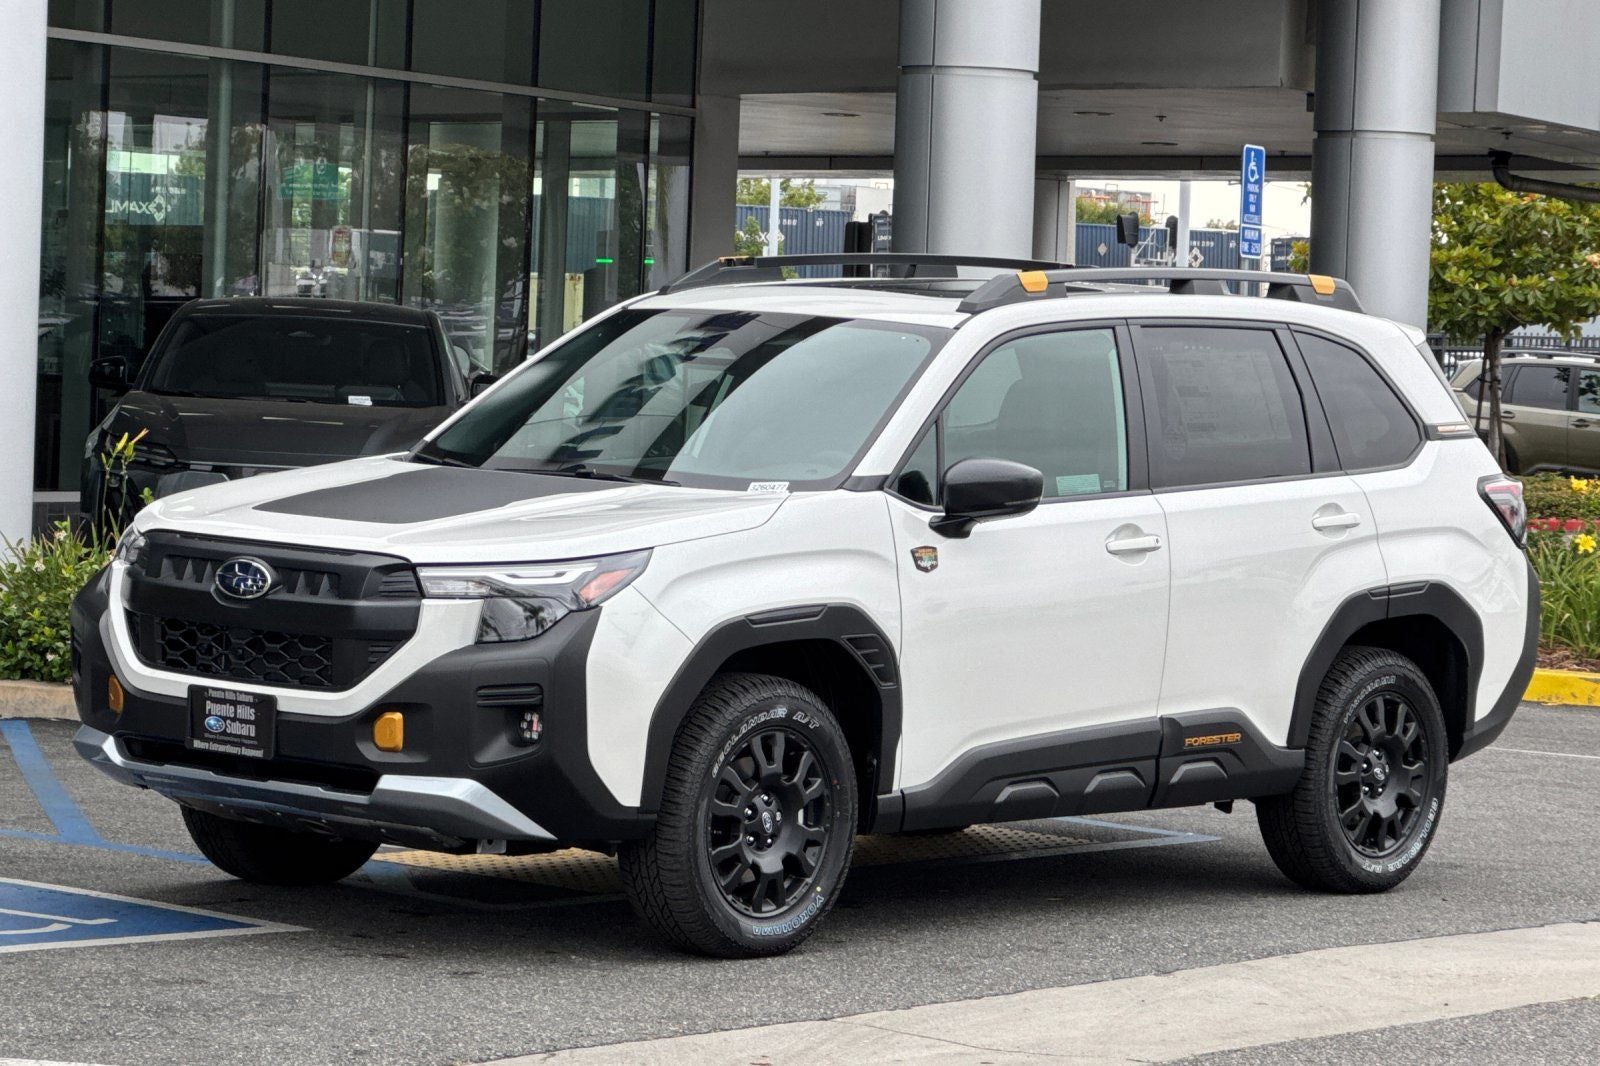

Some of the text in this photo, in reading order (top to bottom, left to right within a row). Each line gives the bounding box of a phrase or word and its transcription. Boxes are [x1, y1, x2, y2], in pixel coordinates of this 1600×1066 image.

[206, 700, 255, 720] Puente Hills
[226, 719, 256, 737] Subaru
[711, 707, 820, 778] GEOLANDAR A/T
[1184, 732, 1241, 746] FORESTER
[753, 895, 825, 936] YOKOHAMA
